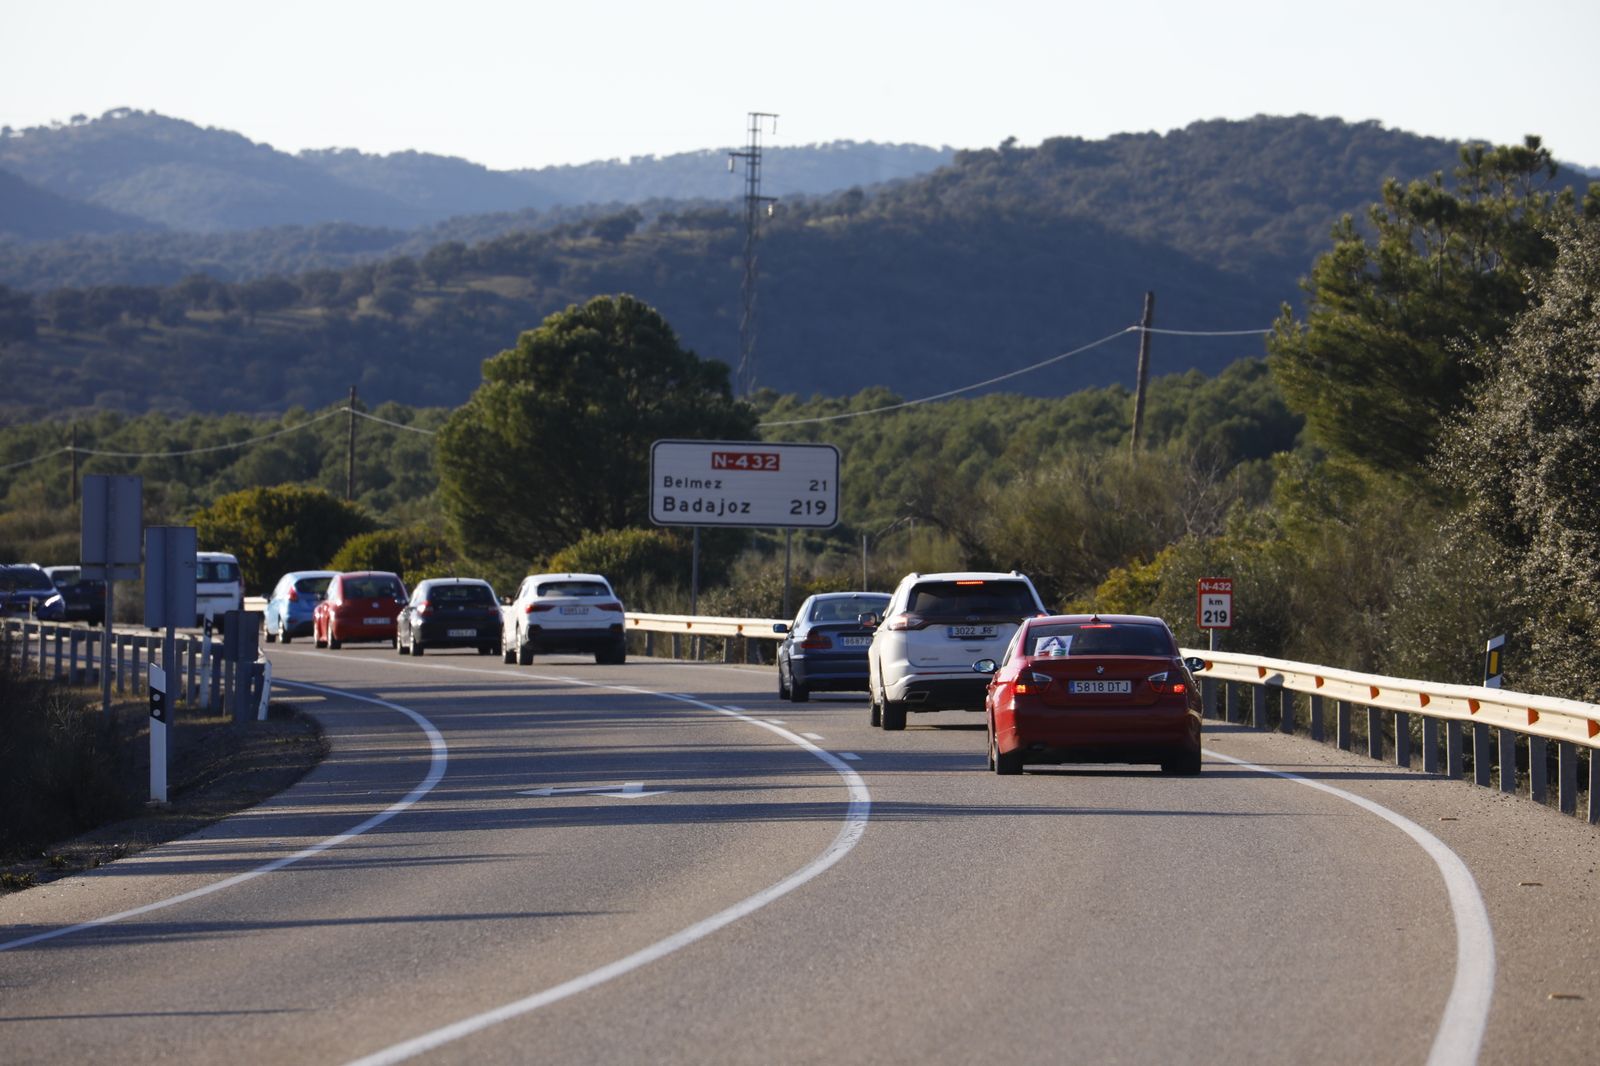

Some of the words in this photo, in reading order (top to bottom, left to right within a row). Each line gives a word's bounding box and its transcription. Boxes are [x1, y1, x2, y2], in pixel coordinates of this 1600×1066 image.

[713, 453, 777, 469] N-432
[663, 475, 722, 489] Belmez
[809, 479, 828, 492] 21
[662, 495, 751, 516] Badajoz
[790, 499, 827, 515] 219
[1200, 581, 1232, 591] N-432
[1208, 597, 1223, 605] km
[1203, 610, 1228, 623] 219
[1076, 682, 1105, 692] 5818
[1107, 682, 1129, 692] DTJ
